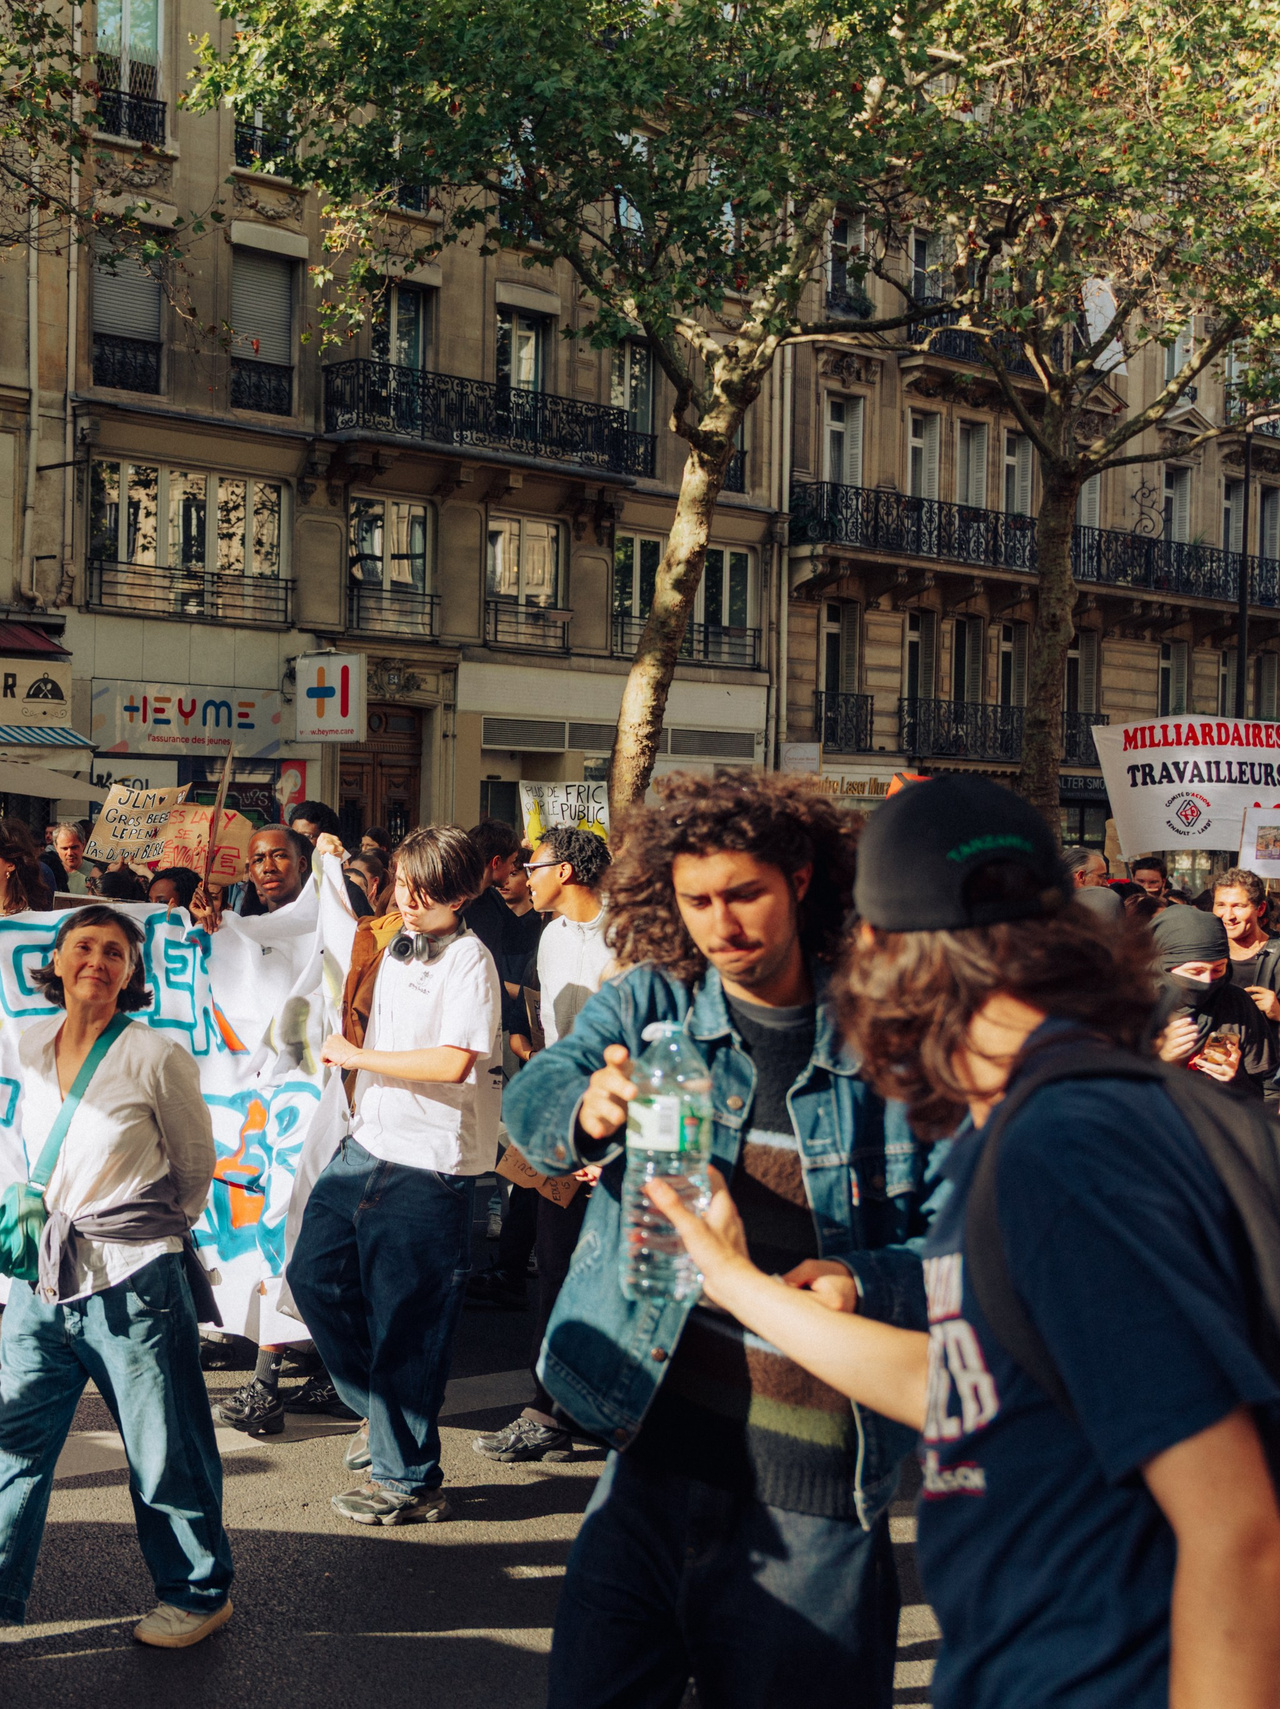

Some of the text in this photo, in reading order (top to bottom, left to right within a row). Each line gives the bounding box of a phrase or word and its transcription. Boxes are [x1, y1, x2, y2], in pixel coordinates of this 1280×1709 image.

[147, 733, 231, 746] l'assurance des jeunes
[547, 786, 559, 798] DE
[565, 785, 604, 804] FRIC
[840, 776, 868, 795] Laser
[118, 789, 157, 809] JLM
[191, 810, 237, 831] LAY
[560, 803, 606, 825] PUBLIC
[174, 828, 193, 840] SE
